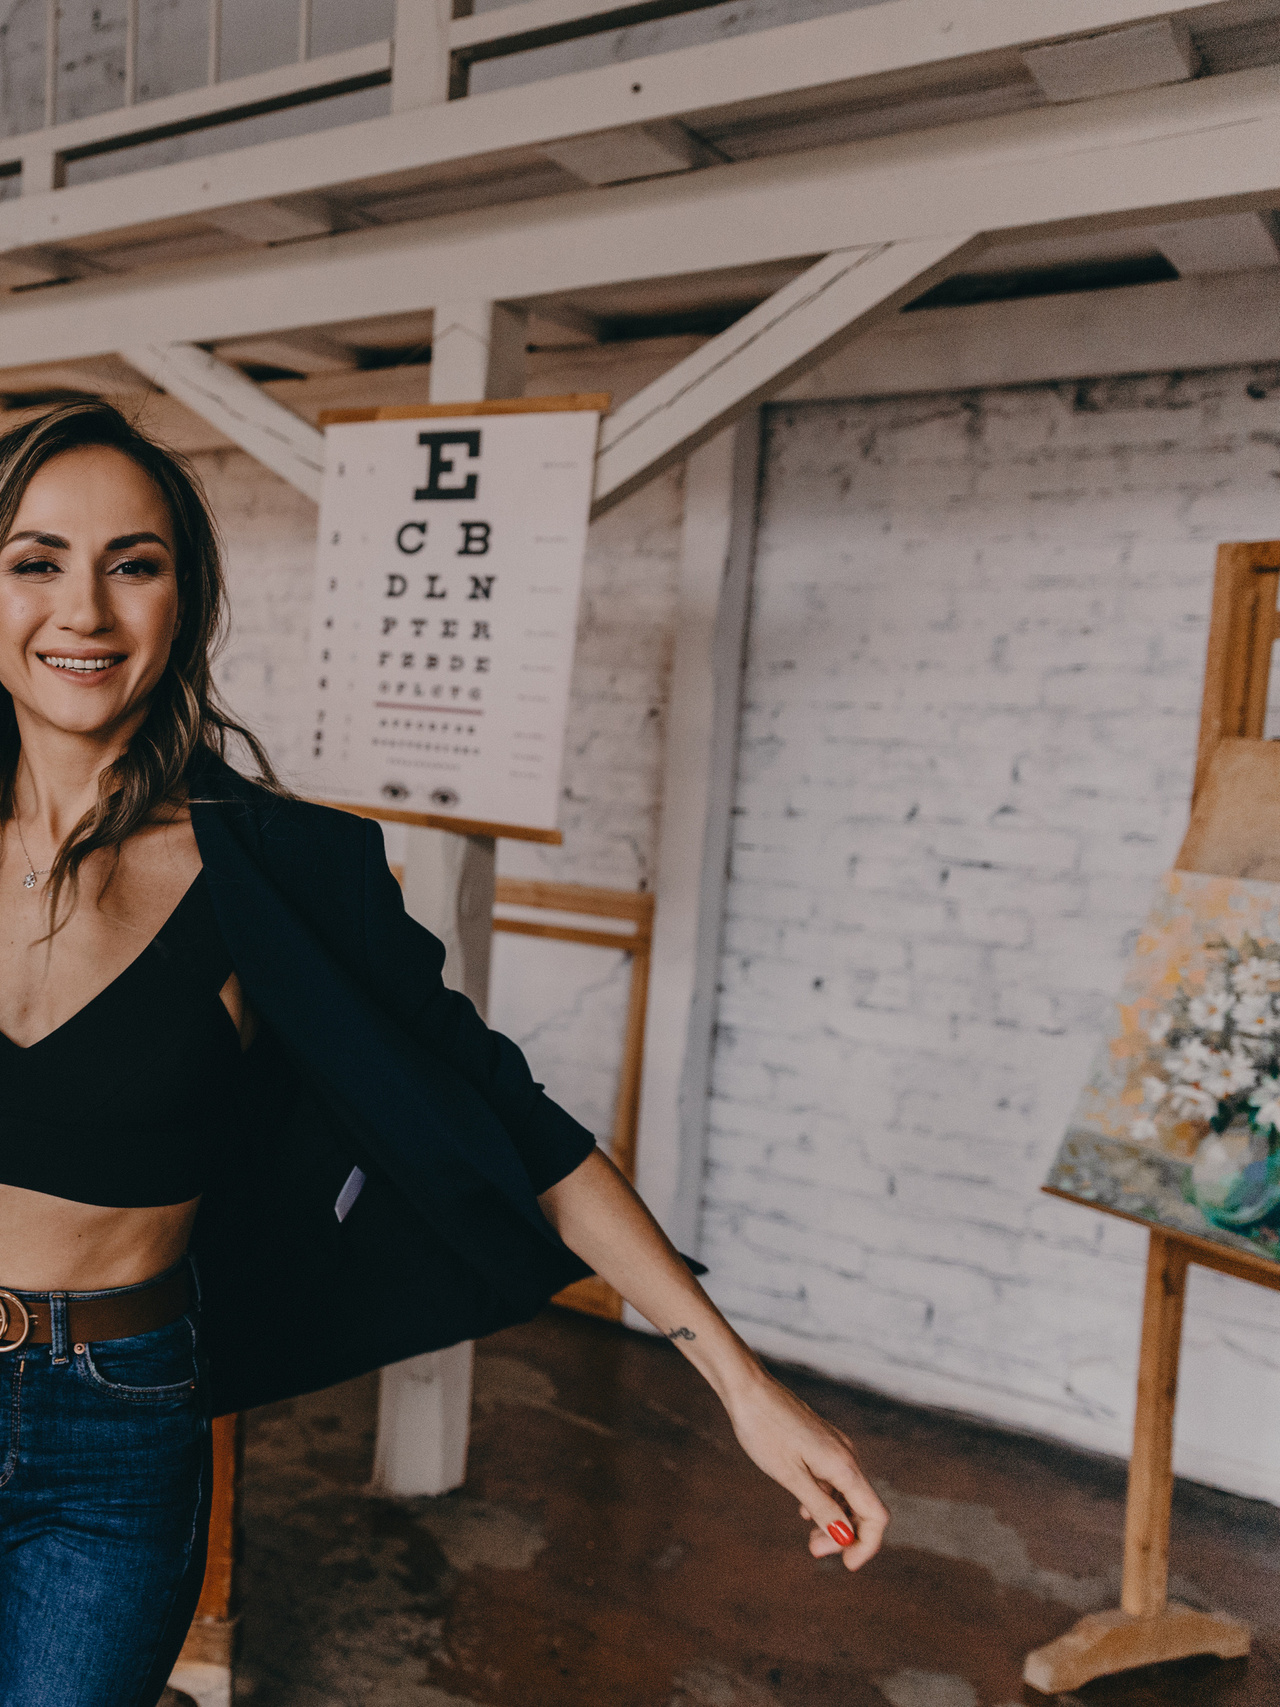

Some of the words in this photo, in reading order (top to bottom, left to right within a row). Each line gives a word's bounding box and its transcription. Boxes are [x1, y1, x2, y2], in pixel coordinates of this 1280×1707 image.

[412, 429, 482, 502] E
[394, 519, 428, 556] C
[456, 519, 493, 557] B
